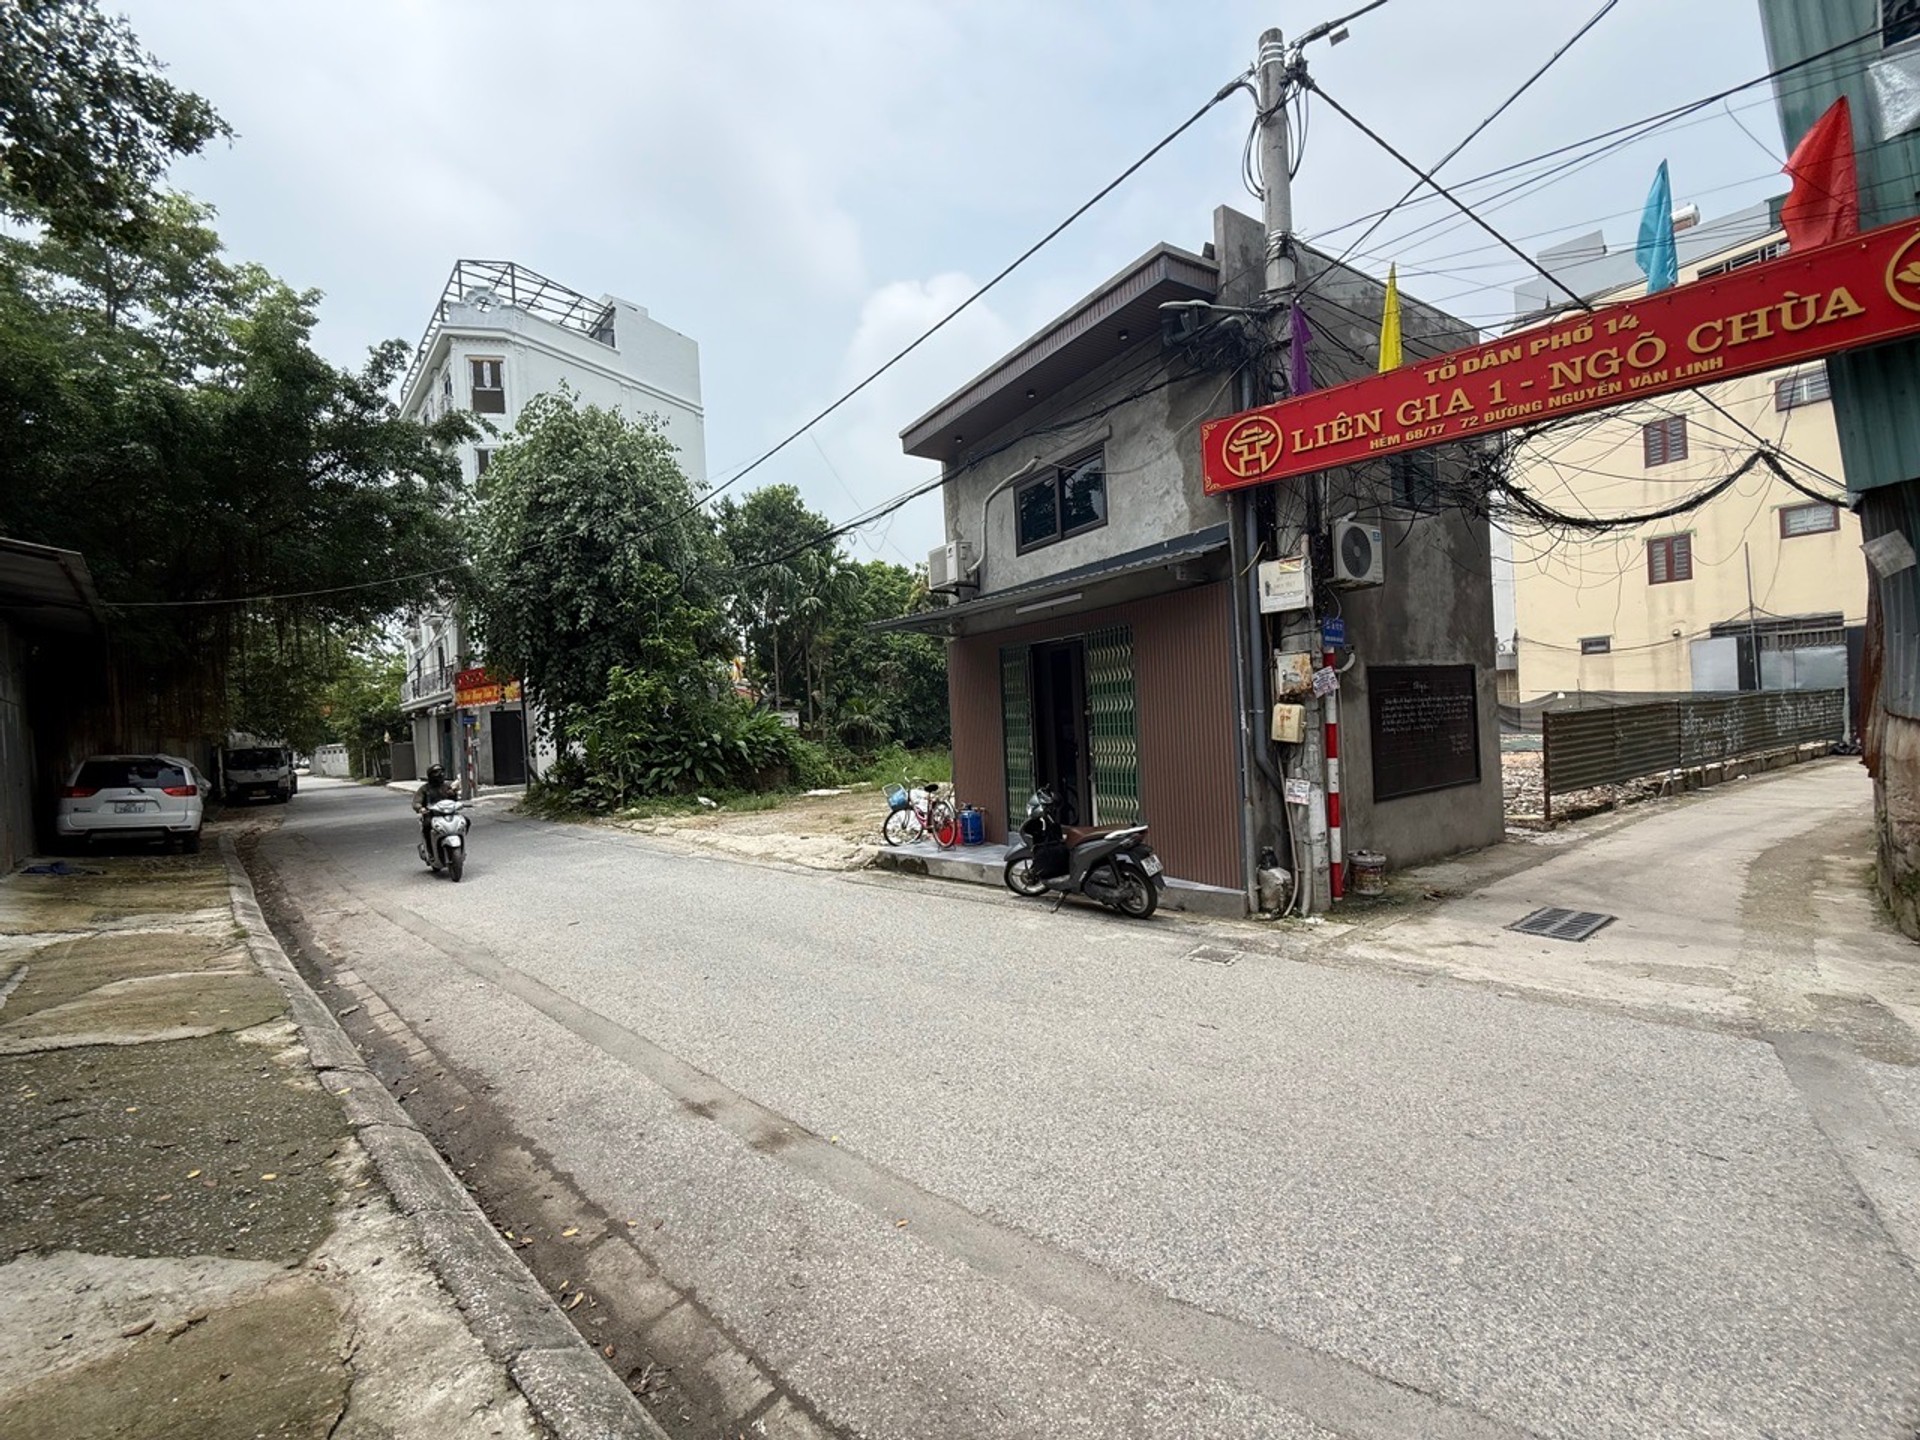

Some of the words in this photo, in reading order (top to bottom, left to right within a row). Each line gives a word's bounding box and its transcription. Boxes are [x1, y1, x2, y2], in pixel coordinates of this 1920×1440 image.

[1291, 408, 1384, 454] LIÊN
[1396, 388, 1475, 427] GIA
[1489, 380, 1508, 406] 1
[1548, 329, 1667, 391] NGÕ
[1687, 286, 1866, 354] CHÙA
[1424, 356, 1456, 384] TỔ
[1462, 345, 1523, 375] DÂN
[1530, 318, 1594, 356] PHỐ
[1603, 314, 1640, 335] 14
[1405, 423, 1446, 442] 68/17
[1460, 415, 1479, 429] 72
[1484, 400, 1543, 423] ĐƯỜNG
[1548, 380, 1623, 408] NGUYỄN
[1628, 368, 1668, 389] VĂN
[1676, 356, 1724, 378] LINH
